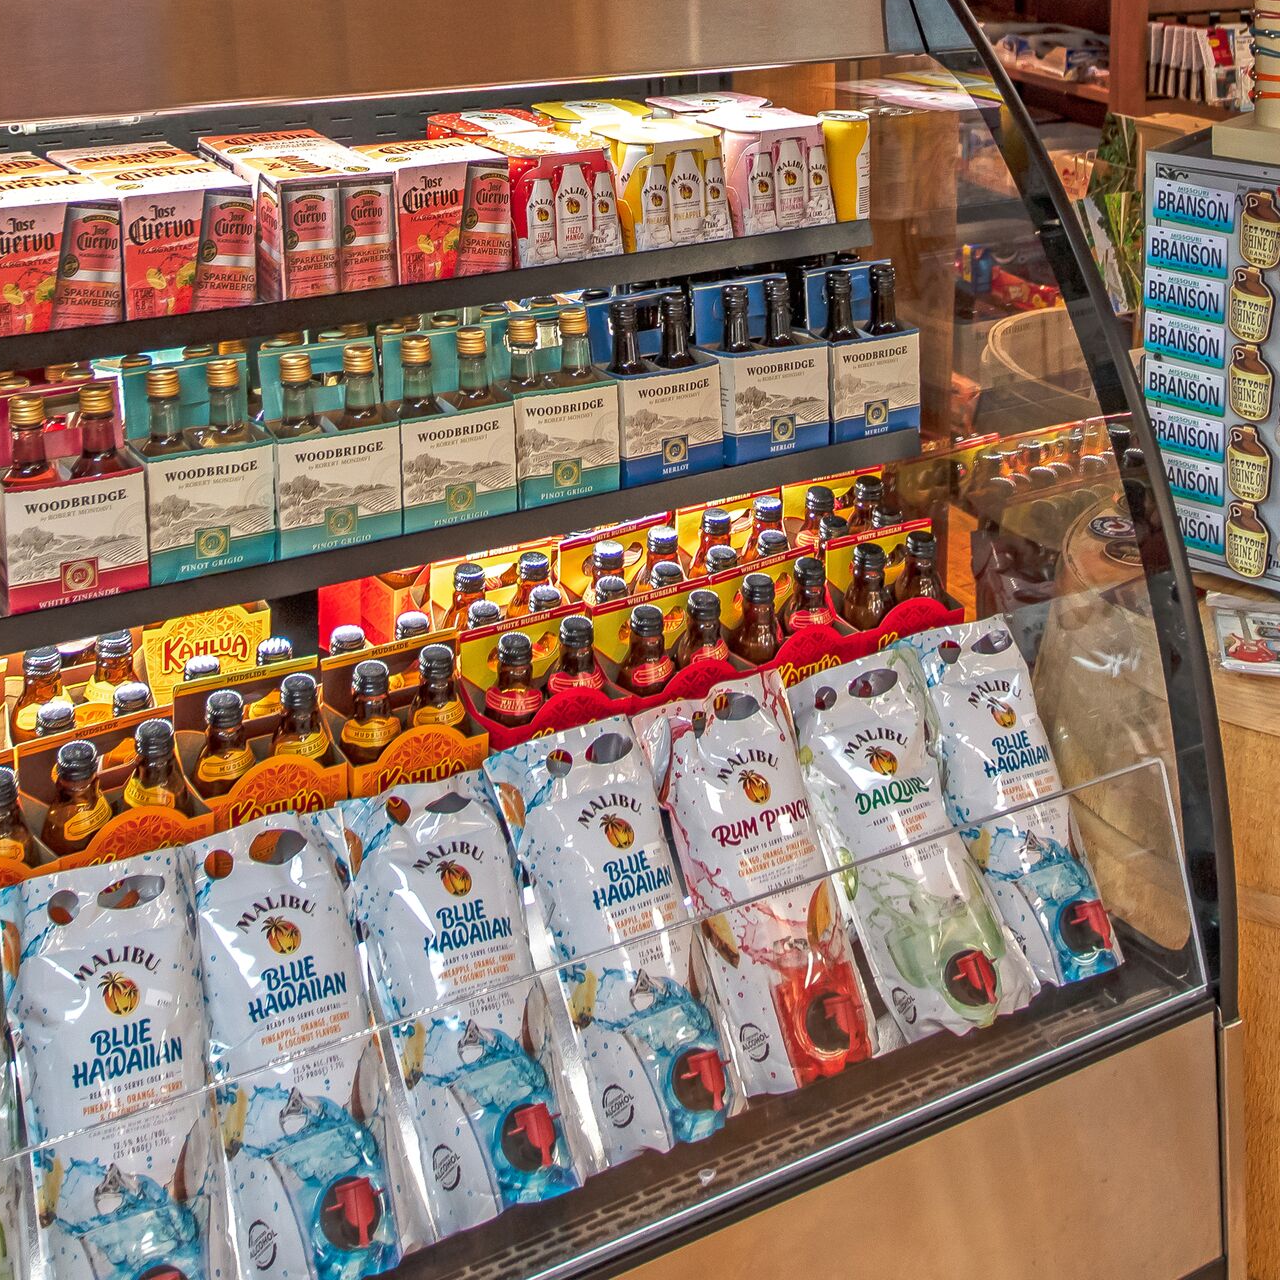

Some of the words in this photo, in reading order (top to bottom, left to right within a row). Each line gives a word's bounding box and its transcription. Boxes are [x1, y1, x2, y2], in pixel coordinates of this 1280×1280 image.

[671, 176, 701, 189] MALIBU
[1177, 185, 1209, 196] MISSOURI
[558, 188, 589, 202] MALIBU
[1158, 190, 1229, 224] BRANSON
[1243, 225, 1258, 234] GET
[1259, 227, 1280, 239] YOUR
[1243, 234, 1269, 251] SHINE
[1151, 238, 1221, 269] BRANSON
[64, 289, 119, 301] SPARKLING
[1149, 280, 1219, 313] BRANSON
[746, 359, 815, 377] WOODBRIDGE
[638, 379, 710, 399] WOODBRIDGE
[526, 399, 604, 418] WOODBRIDGE
[418, 421, 500, 442] WOODBRIDGE
[295, 442, 384, 465] WOODBRIDGE
[165, 460, 257, 483] WOODBRIDGE
[662, 465, 689, 475] MERLOT
[25, 489, 126, 514] WOODBRIDGE
[181, 563, 210, 573] PINOT
[214, 556, 243, 568] GRIGIO
[741, 564, 760, 573] WHITE
[762, 554, 785, 566] RUSSIAN
[497, 619, 521, 632] WHITE
[522, 612, 550, 626] RUSSIAN
[163, 632, 247, 674] KAHLÚA
[371, 641, 406, 657] MUDSLIDE
[712, 816, 762, 847] RUM
[762, 796, 809, 831] PUNCH
[235, 895, 315, 934] MALIBU
[437, 899, 485, 932] BLUE
[73, 947, 159, 987] MALIBU
[261, 957, 314, 991] BLUE
[249, 972, 346, 1021] HAWAIIAN
[91, 1019, 151, 1055] BLUE
[72, 1037, 183, 1089] HAWAIIAN
